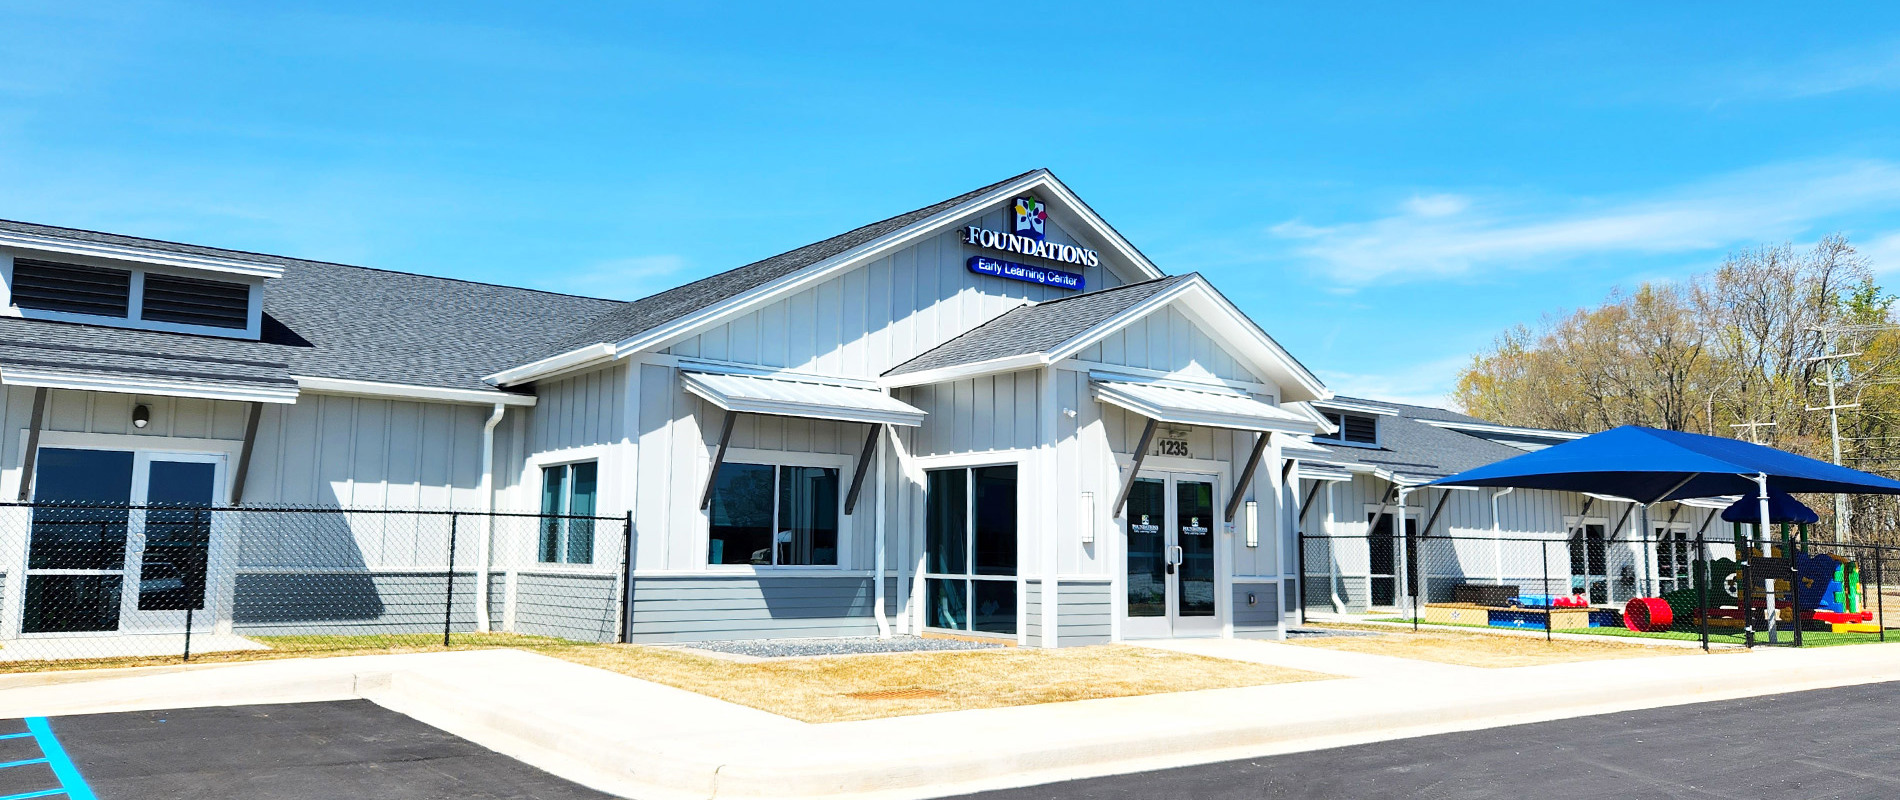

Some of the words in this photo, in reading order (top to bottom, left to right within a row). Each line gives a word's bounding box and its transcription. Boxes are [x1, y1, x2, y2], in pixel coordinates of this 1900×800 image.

[967, 226, 1099, 267] FOUNDATIONS
[978, 258, 1002, 275] Early
[1004, 263, 1045, 283] Learning
[1047, 271, 1078, 286] Center
[1159, 439, 1189, 457] 1235
